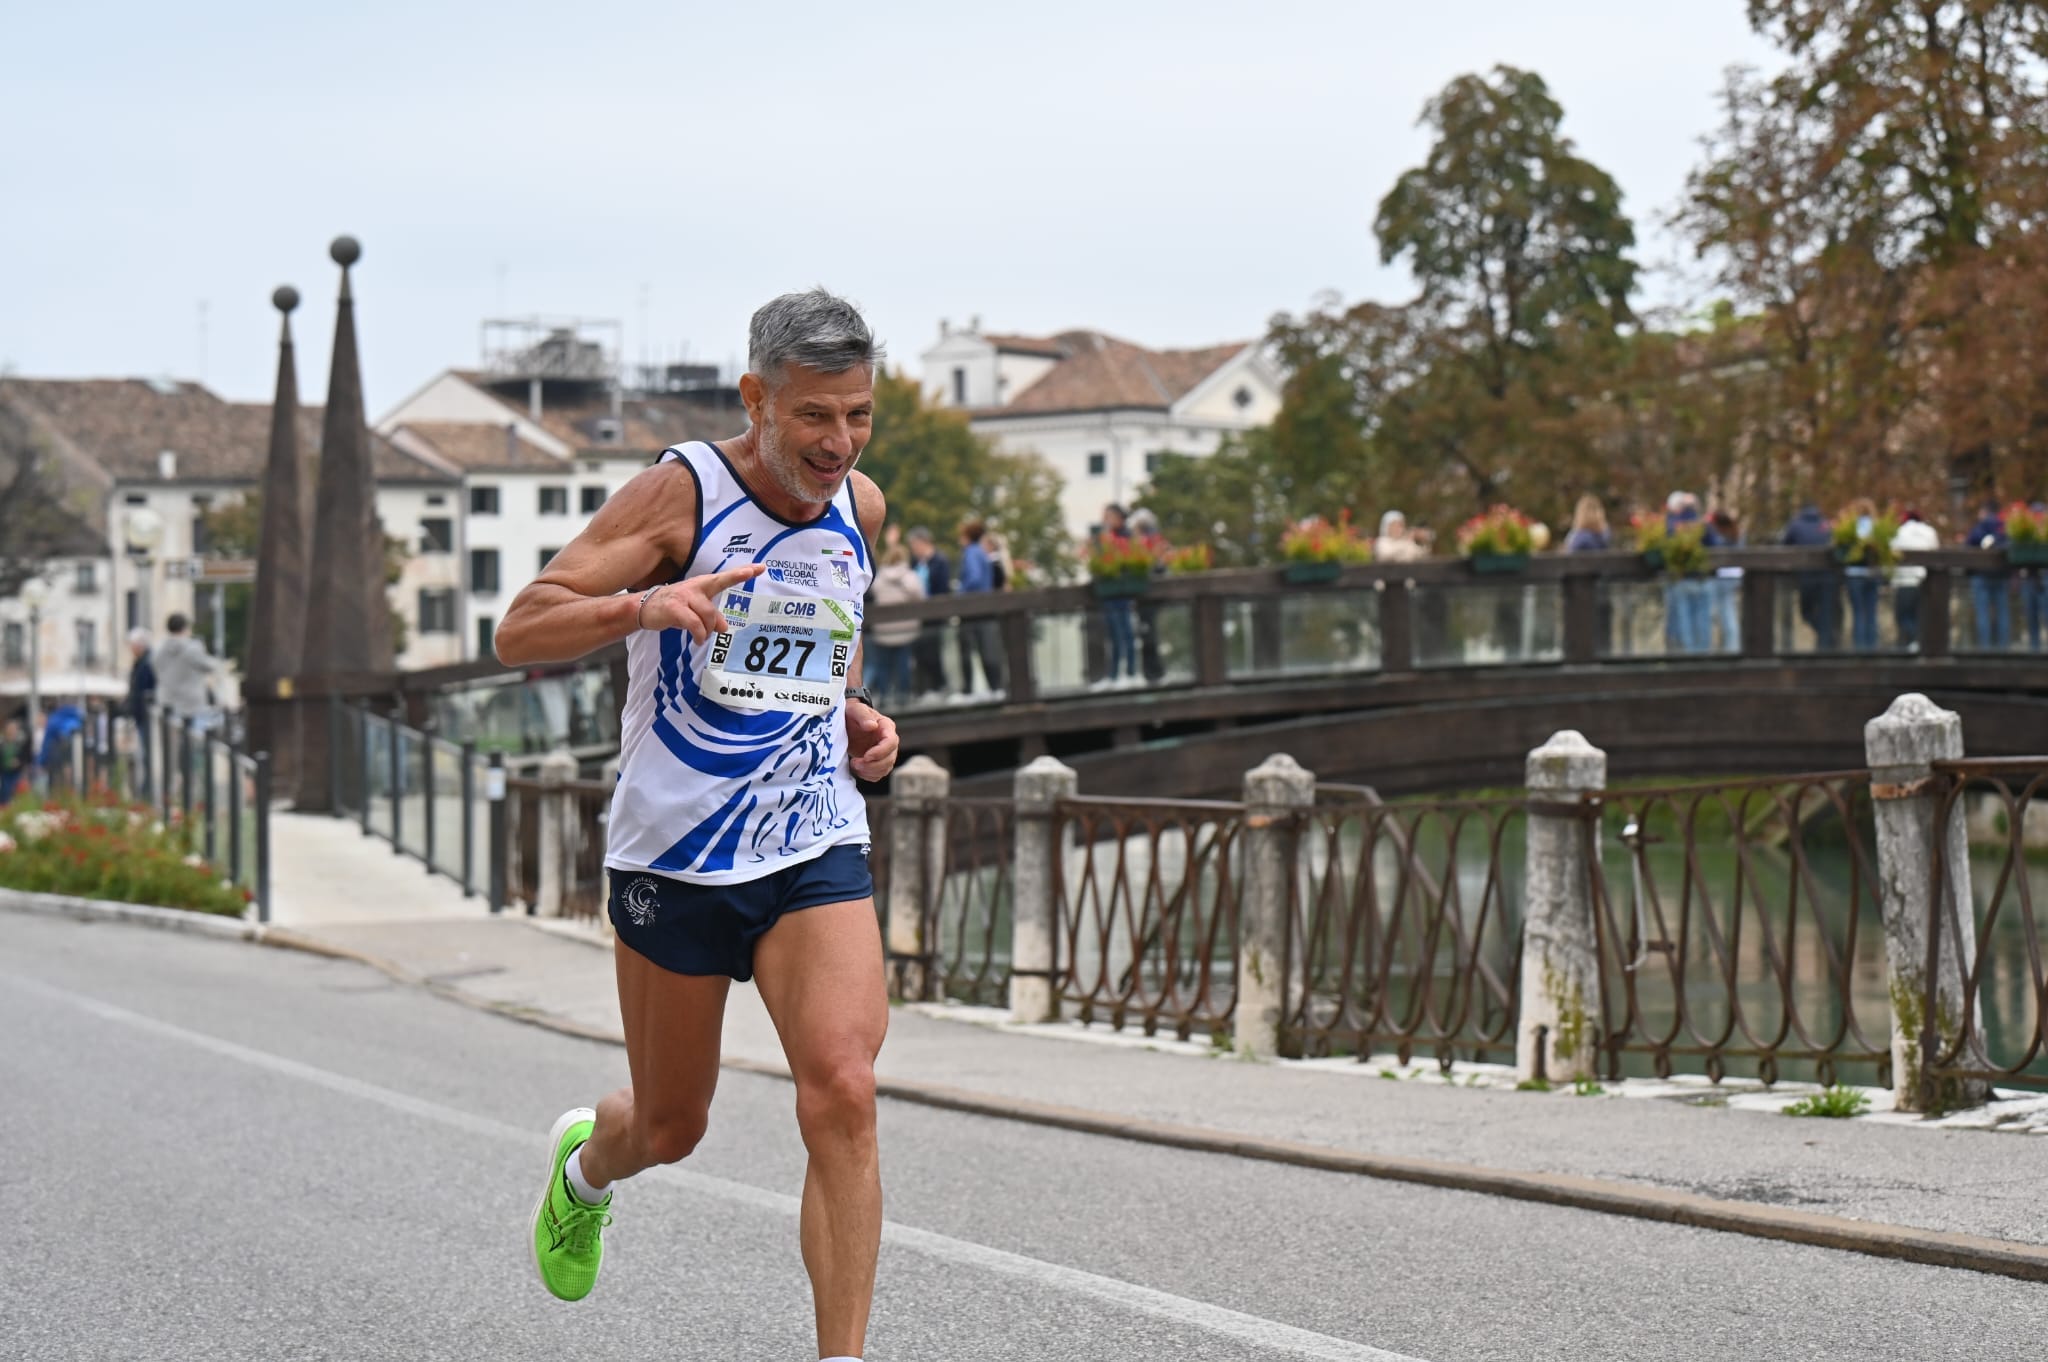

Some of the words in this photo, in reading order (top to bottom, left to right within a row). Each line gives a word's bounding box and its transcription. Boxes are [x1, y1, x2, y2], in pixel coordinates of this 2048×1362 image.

[766, 560, 818, 571] CONSULTING
[784, 569, 816, 579] GLOBAL
[785, 577, 819, 587] SERVICE
[784, 602, 817, 617] CMB
[758, 624, 791, 634] SALVATORE
[791, 626, 814, 636] BRUNO
[744, 636, 816, 677] 827
[792, 692, 830, 706] cisalfa
